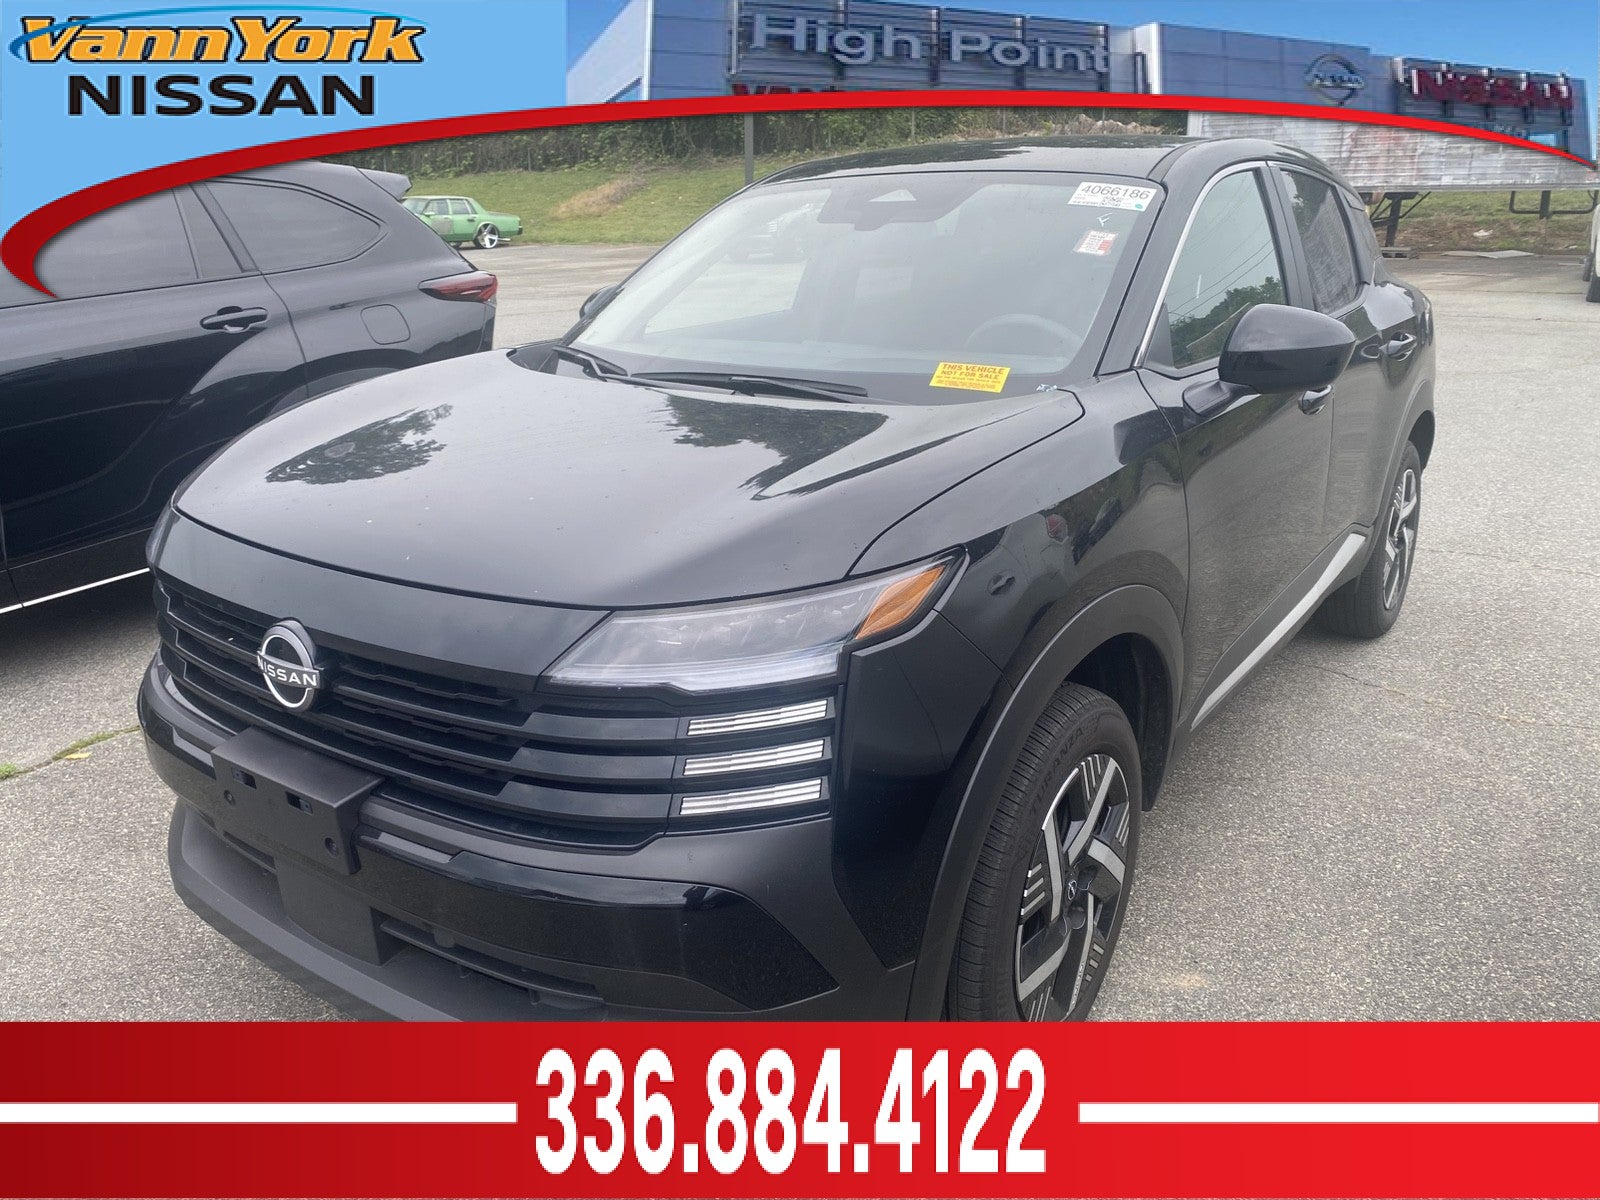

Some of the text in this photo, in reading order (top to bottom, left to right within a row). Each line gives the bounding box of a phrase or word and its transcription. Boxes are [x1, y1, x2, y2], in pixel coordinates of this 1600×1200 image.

[1081, 184, 1151, 200] 4066186
[966, 365, 1004, 375] VEHICLE
[257, 655, 317, 687] NISSAN
